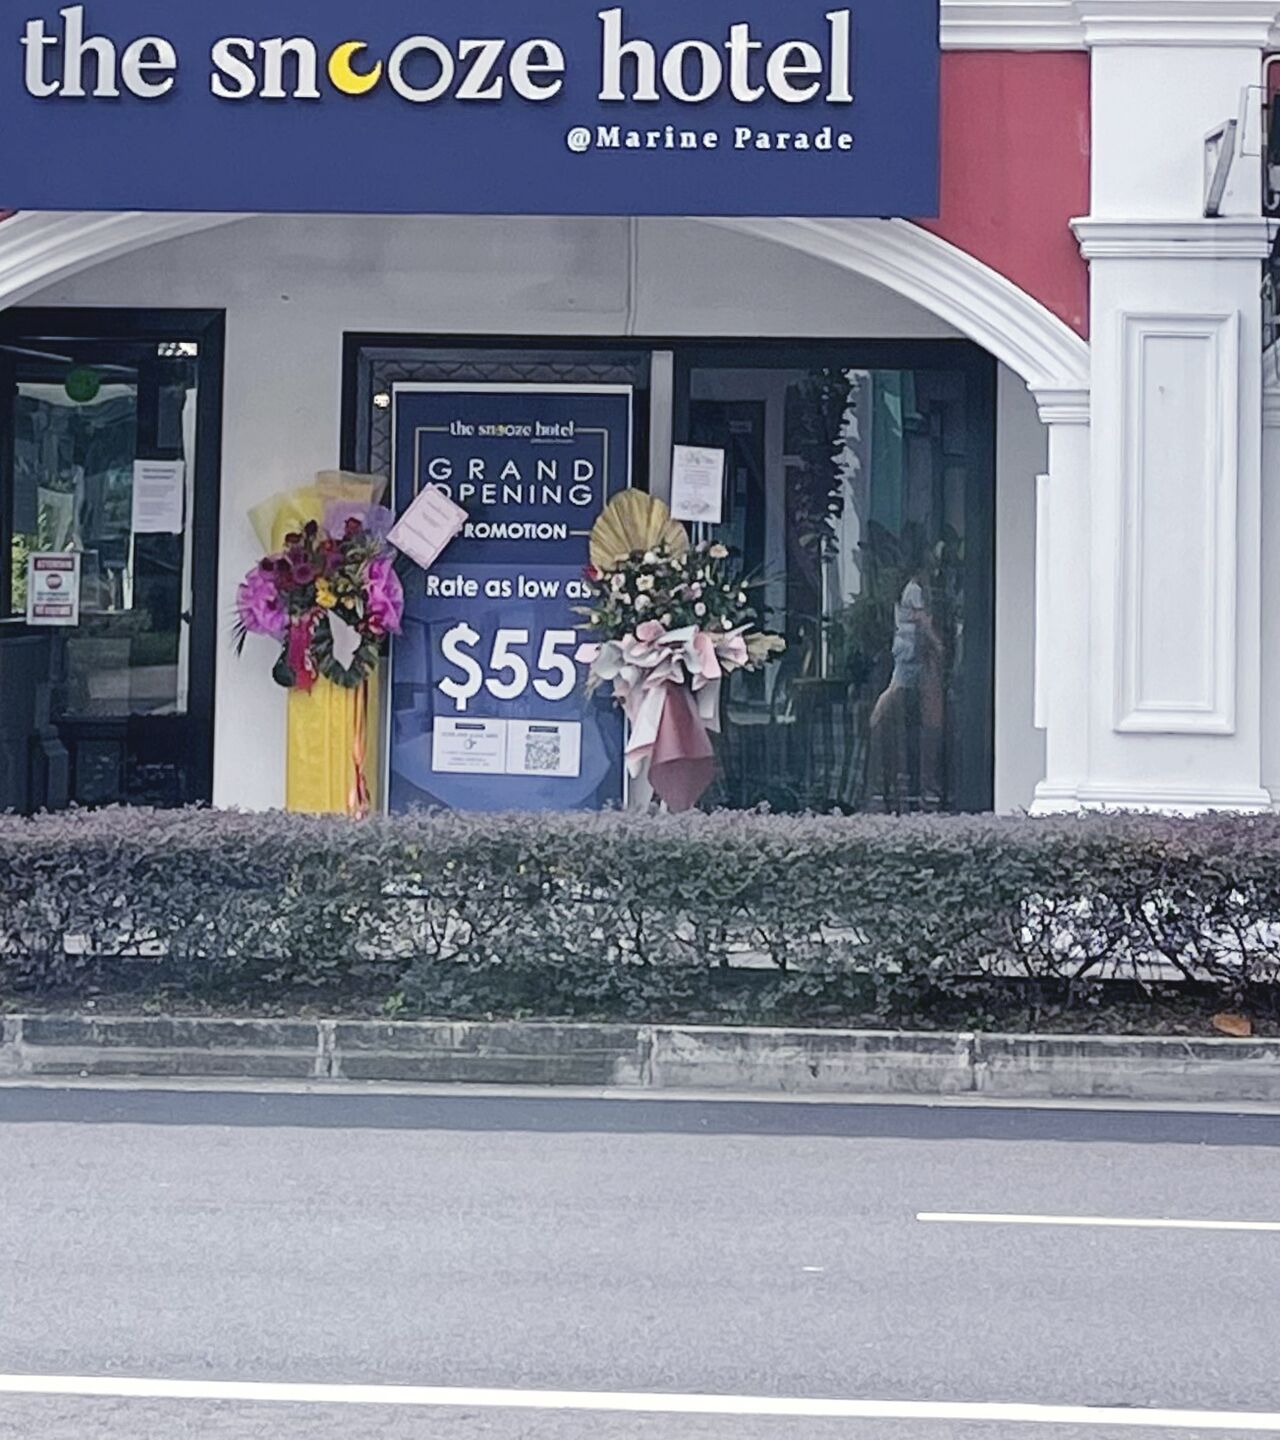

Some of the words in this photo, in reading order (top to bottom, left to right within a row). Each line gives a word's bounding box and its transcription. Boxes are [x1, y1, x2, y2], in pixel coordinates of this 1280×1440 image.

[20, 5, 177, 98] the
[598, 8, 853, 104] hotel
[567, 125, 718, 152] @Marine
[734, 126, 853, 151] Parade
[450, 420, 475, 436] the
[535, 420, 575, 437] hotel
[427, 457, 594, 482] GRAND
[464, 521, 568, 540] ROMOTION
[426, 574, 479, 598] Rate
[484, 579, 512, 598] as
[518, 574, 560, 599] low
[565, 580, 592, 599] as
[438, 622, 577, 711] $55
